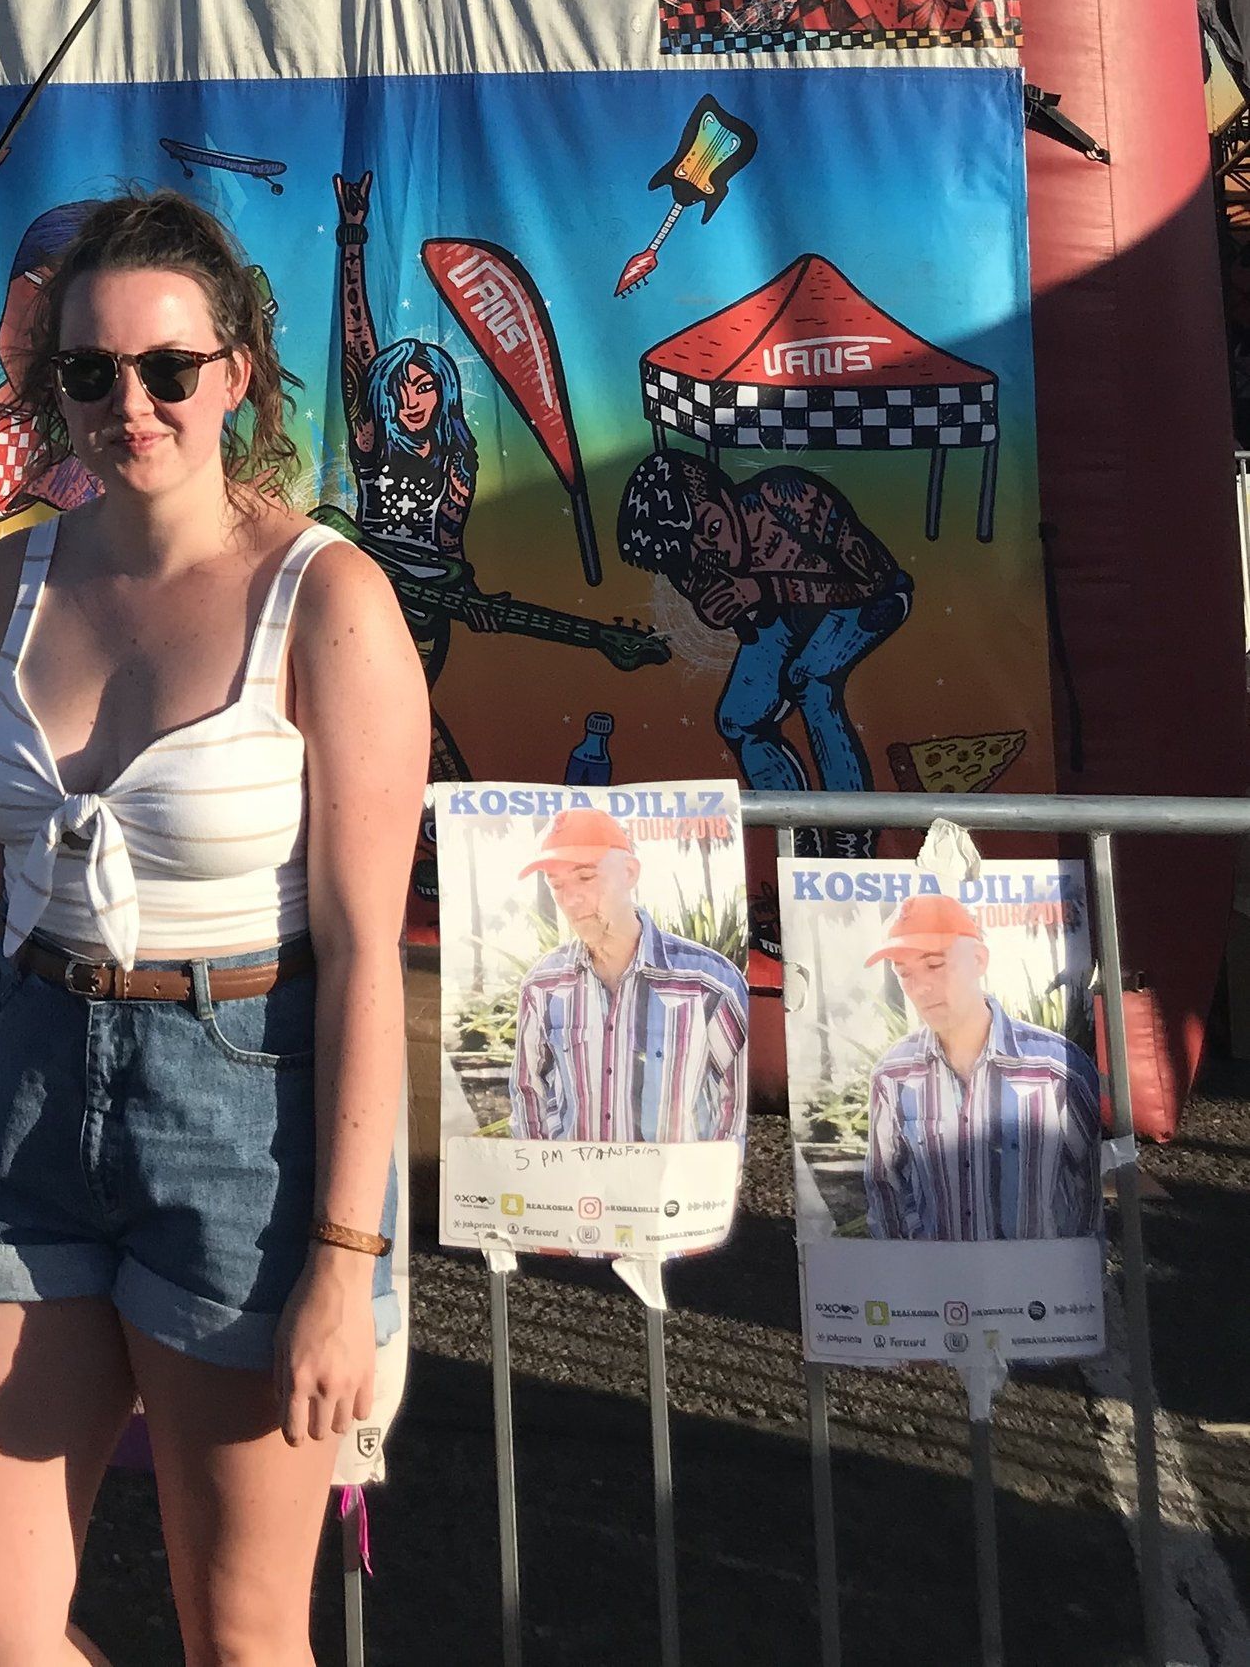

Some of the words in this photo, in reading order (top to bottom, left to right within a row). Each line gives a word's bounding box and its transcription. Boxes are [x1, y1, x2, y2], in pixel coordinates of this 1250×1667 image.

[764, 336, 891, 377] VANS
[449, 790, 592, 817] KOSHA
[607, 790, 726, 818] DILLZ
[793, 870, 943, 903] KOSHA
